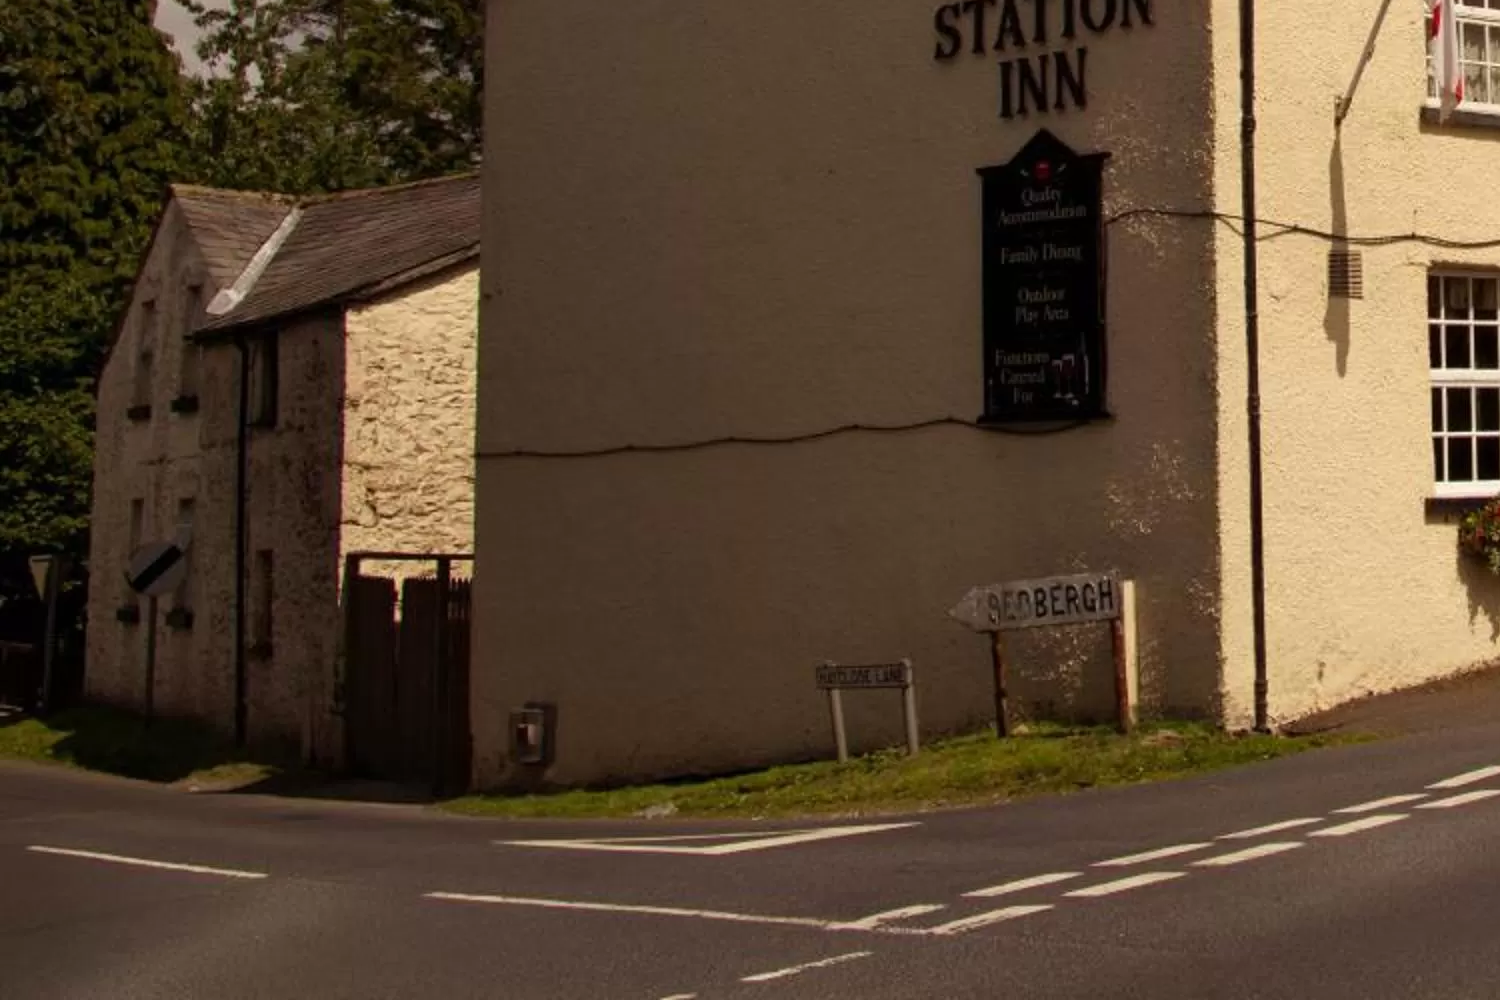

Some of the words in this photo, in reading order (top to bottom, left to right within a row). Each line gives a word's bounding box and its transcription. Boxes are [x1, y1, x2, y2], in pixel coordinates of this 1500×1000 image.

[1000, 46, 1087, 117] INN
[1021, 185, 1061, 206] Quality
[1001, 245, 1038, 265] Family
[1041, 241, 1083, 264] Dining
[1017, 284, 1066, 304] Outdoor
[1043, 303, 1069, 321] Area
[987, 577, 1114, 626] SEDBERGH
